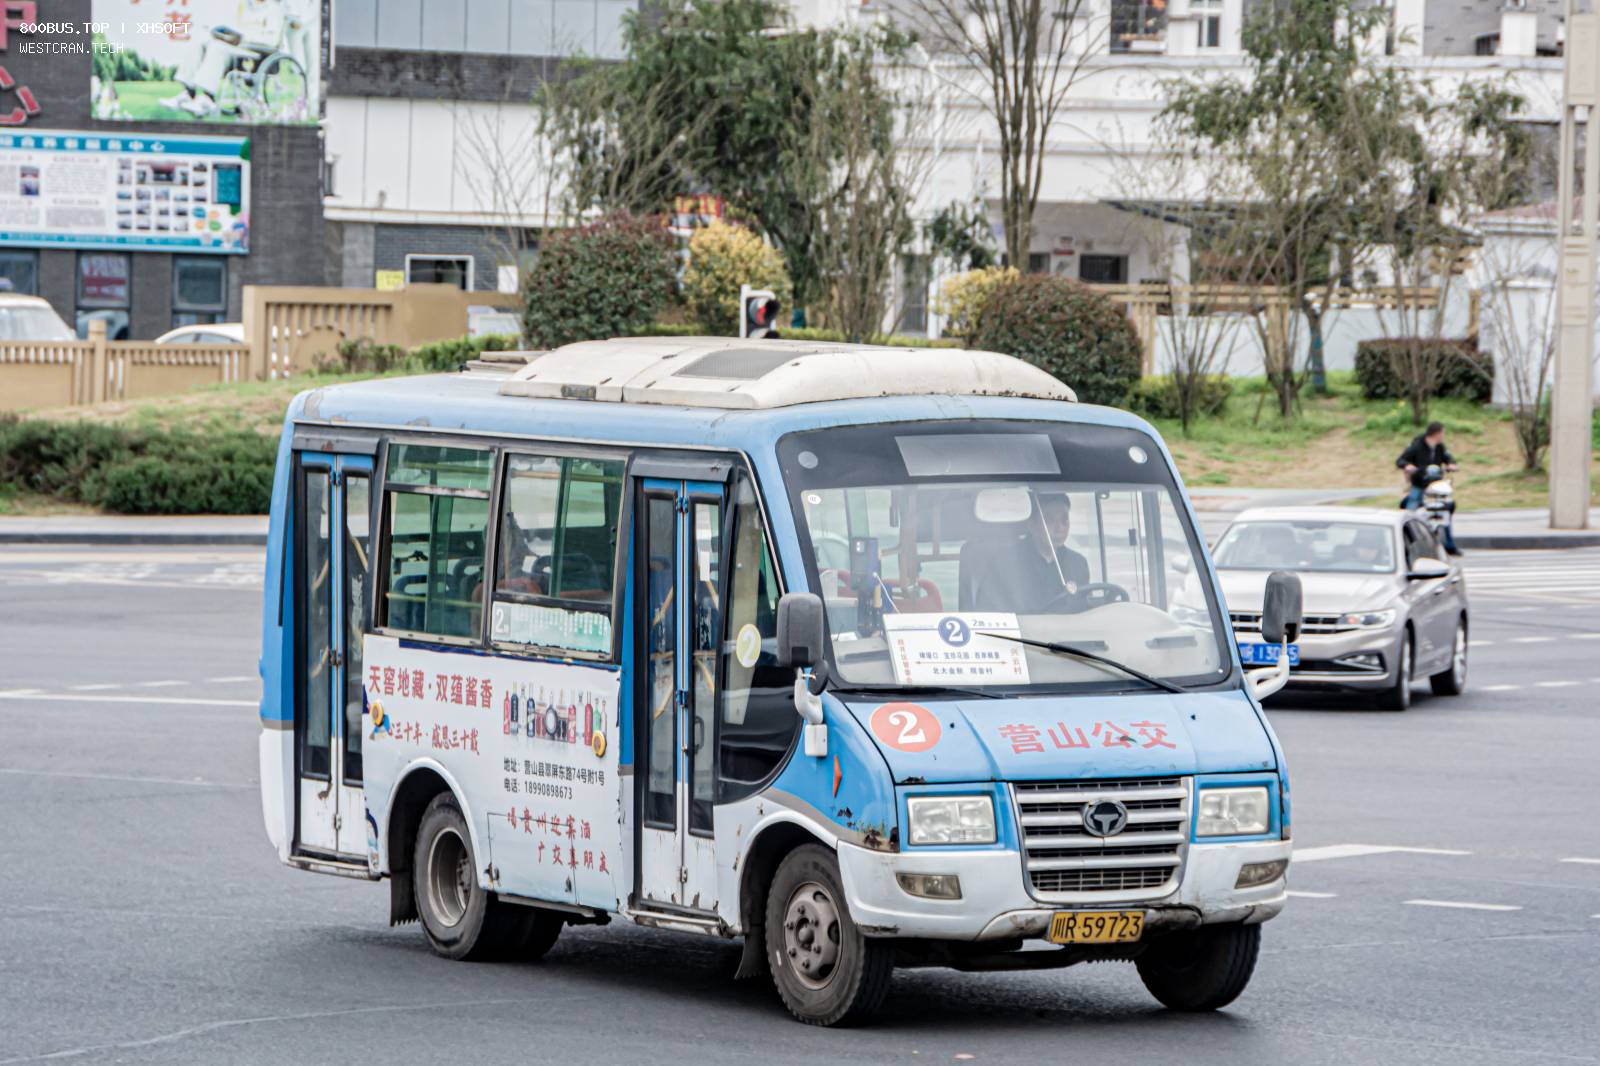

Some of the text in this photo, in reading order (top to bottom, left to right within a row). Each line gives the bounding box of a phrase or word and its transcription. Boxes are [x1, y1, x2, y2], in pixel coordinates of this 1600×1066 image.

[743, 630, 756, 666] 2
[945, 620, 964, 642] 2
[889, 711, 926, 744] 2
[998, 720, 1177, 755] 营山公交
